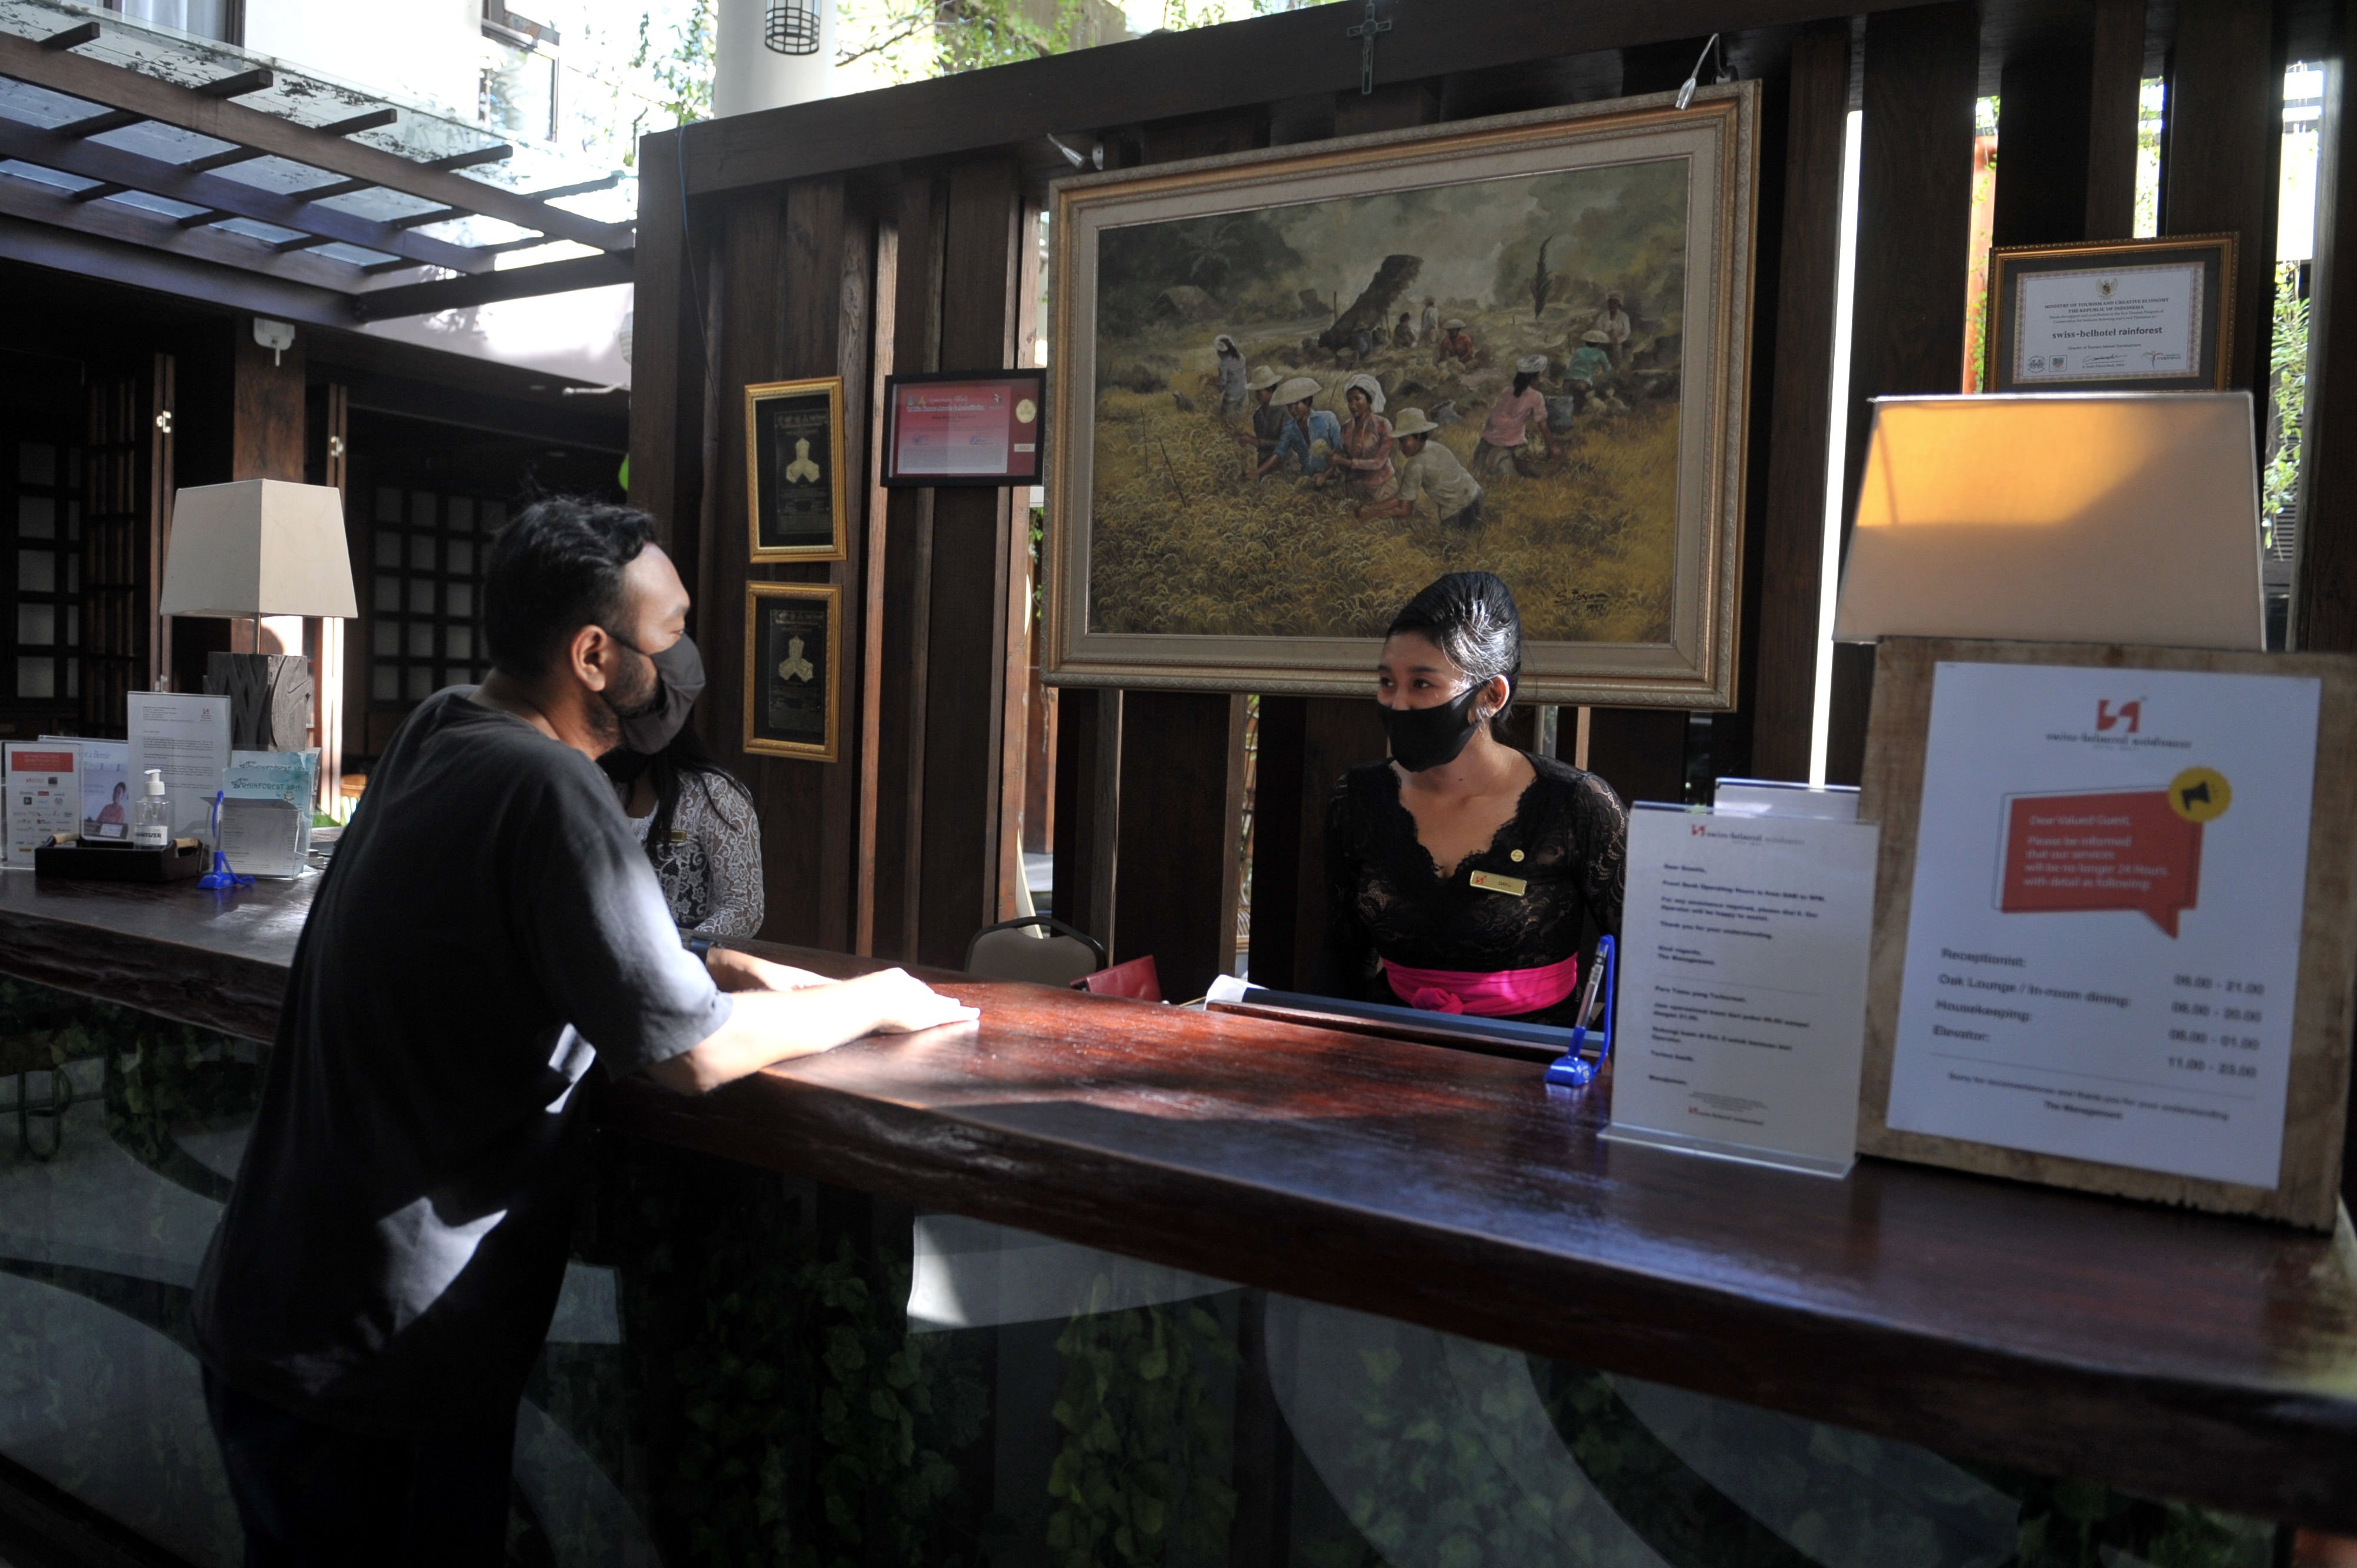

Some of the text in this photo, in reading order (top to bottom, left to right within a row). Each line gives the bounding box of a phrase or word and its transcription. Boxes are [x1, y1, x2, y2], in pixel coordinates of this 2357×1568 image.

[2052, 329, 2116, 338] swiss-belhotel
[2030, 815, 2131, 825] Dear Valued Guest,
[2028, 836, 2132, 846] Please be informed
[2028, 850, 2115, 859] that our services
[2025, 863, 2043, 872] will
[2047, 864, 2060, 872] be
[2078, 864, 2115, 877] longer
[2024, 877, 2047, 886] with
[2050, 877, 2079, 887] detail
[2082, 879, 2094, 887] as
[1701, 884, 1733, 893] Operating
[1941, 949, 2026, 967] Receptionist:
[1938, 974, 1964, 986] Oak
[1967, 978, 2016, 993] Lounge
[2028, 985, 2082, 1000] In-room
[2085, 992, 2131, 1008] dining:
[1935, 1001, 2032, 1022] Housekeeping:
[1933, 1025, 1990, 1041] Elevator:
[2045, 1101, 2122, 1119] The Management
